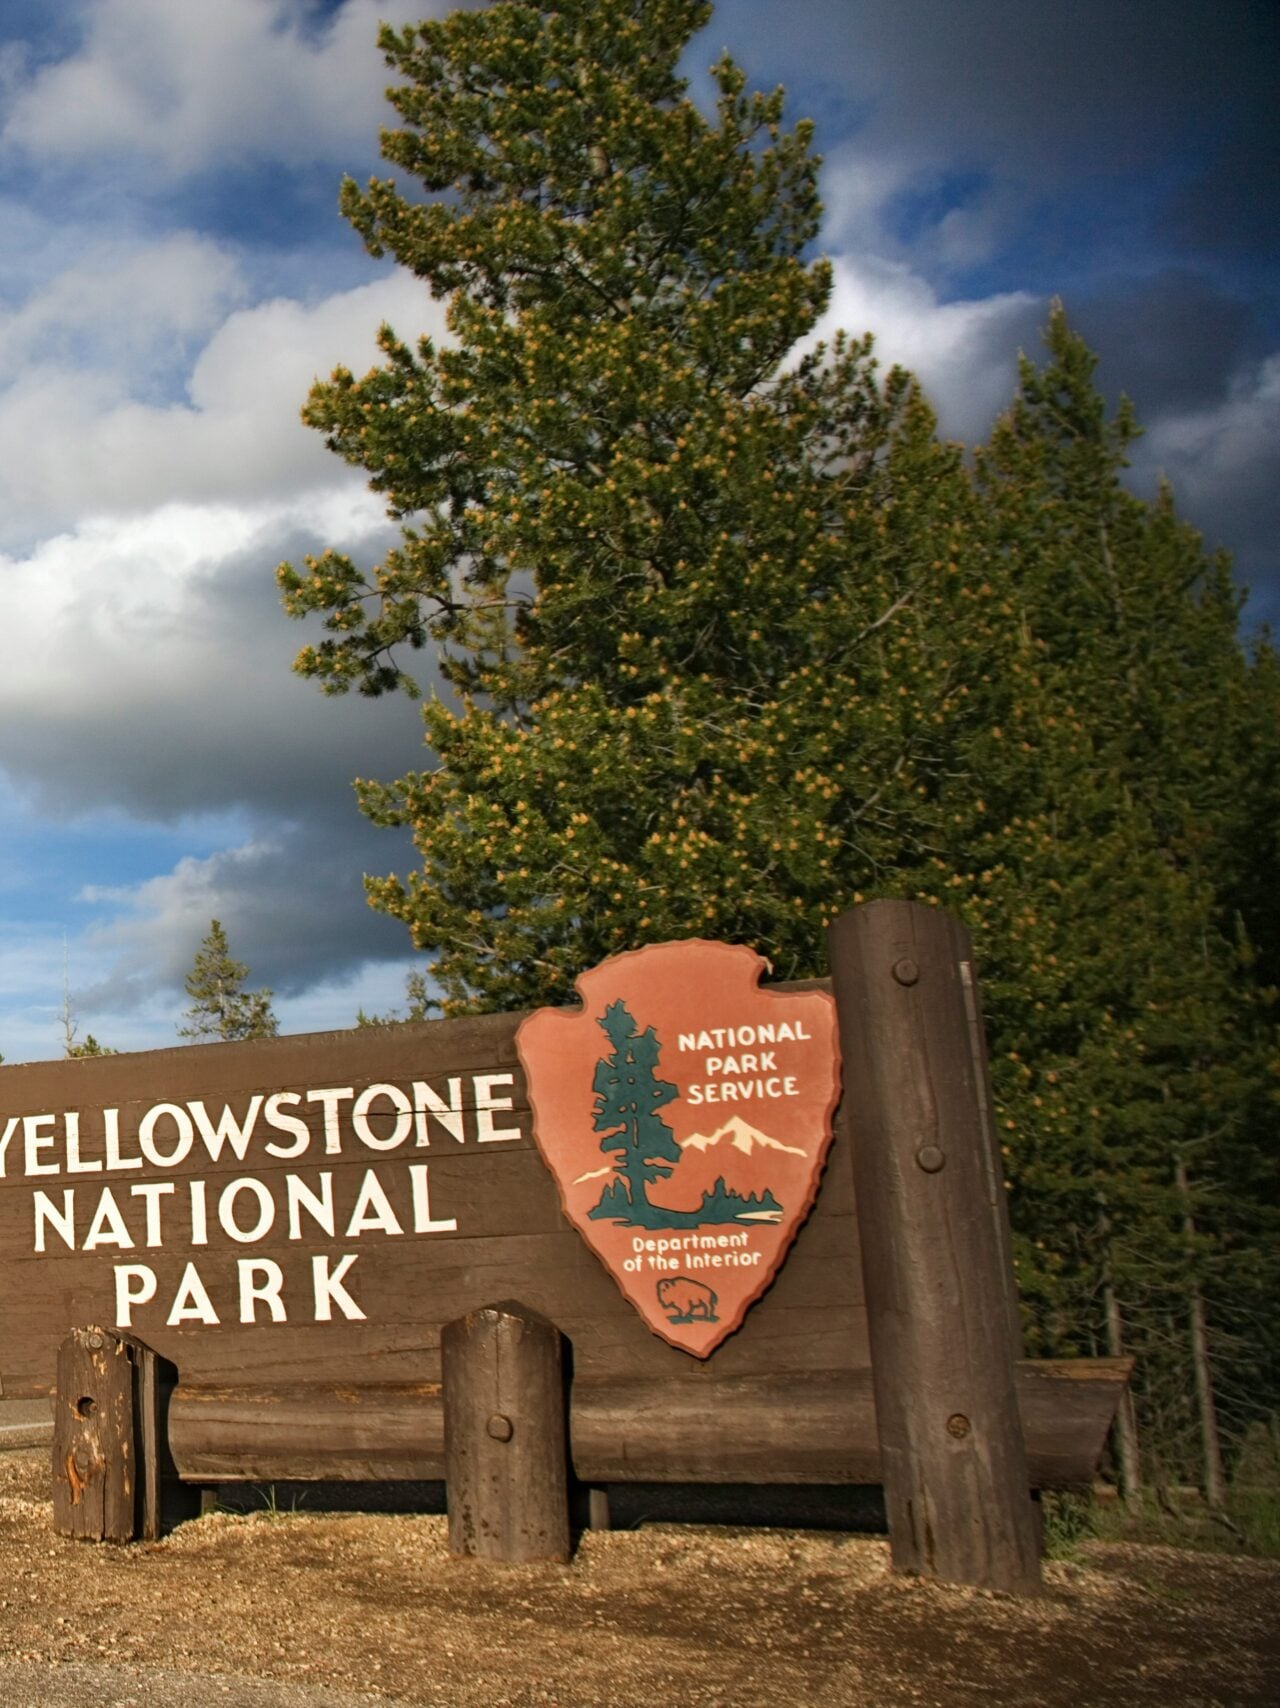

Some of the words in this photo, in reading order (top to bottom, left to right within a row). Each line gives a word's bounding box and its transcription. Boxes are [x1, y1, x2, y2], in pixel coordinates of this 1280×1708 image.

[677, 1020, 811, 1052] NATIONAL
[705, 1051, 778, 1077] PARK
[687, 1076, 800, 1105] SERVICE
[32, 1164, 458, 1253] NATIONAL
[632, 1231, 749, 1255] Department
[623, 1256, 643, 1272] of
[648, 1253, 679, 1270] the
[685, 1251, 762, 1269] Interior
[112, 1254, 368, 1328] PARK
